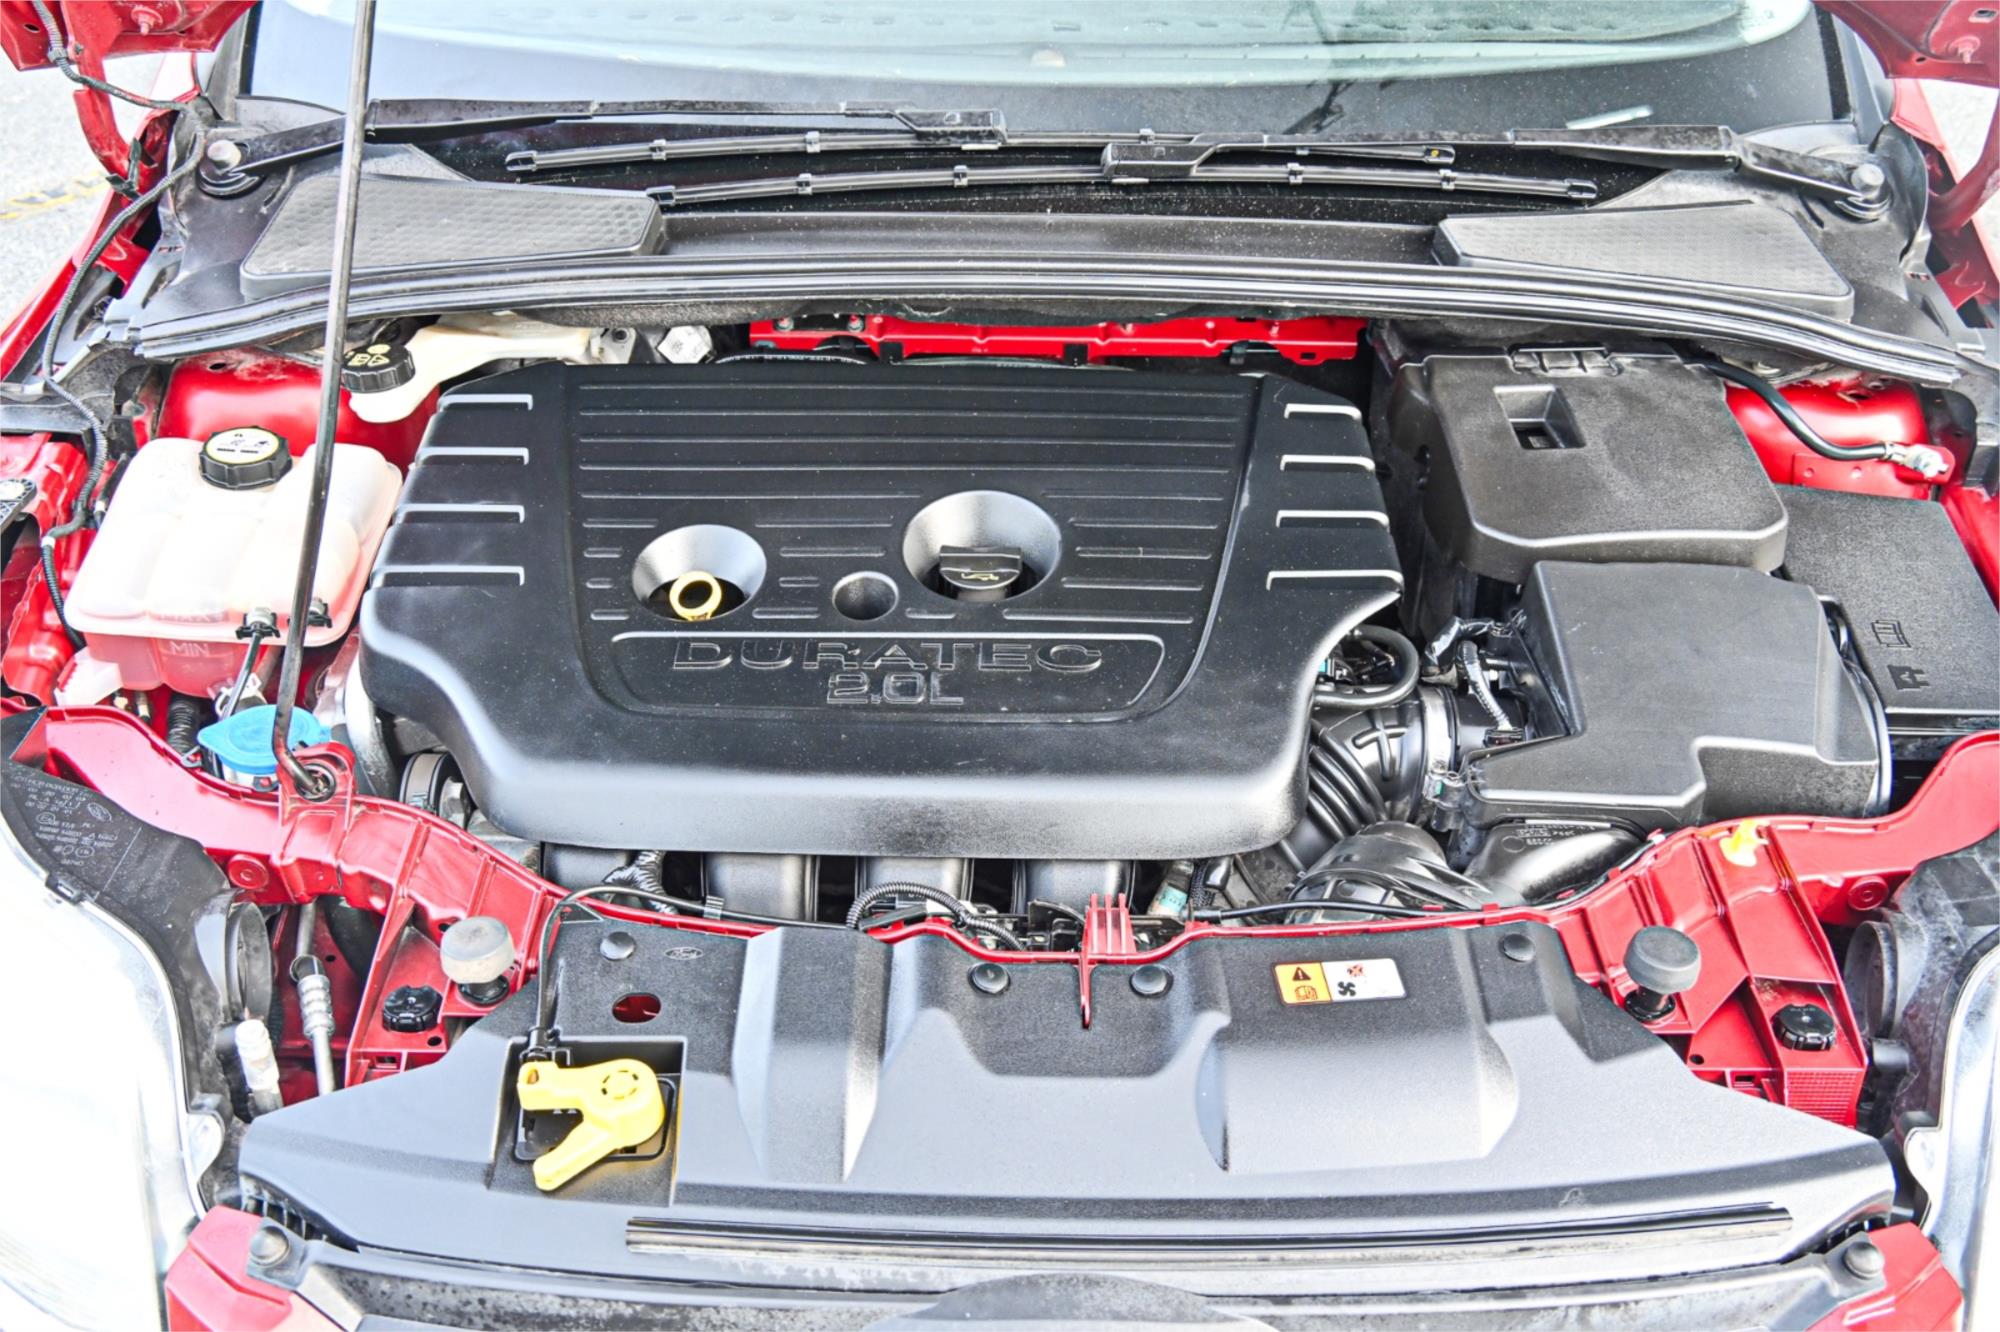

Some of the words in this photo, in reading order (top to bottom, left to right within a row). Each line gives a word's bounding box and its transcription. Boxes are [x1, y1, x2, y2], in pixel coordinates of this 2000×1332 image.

[168, 641, 210, 658] MIN
[672, 639, 1102, 672] DURATEC
[826, 671, 964, 706] 2.0L
